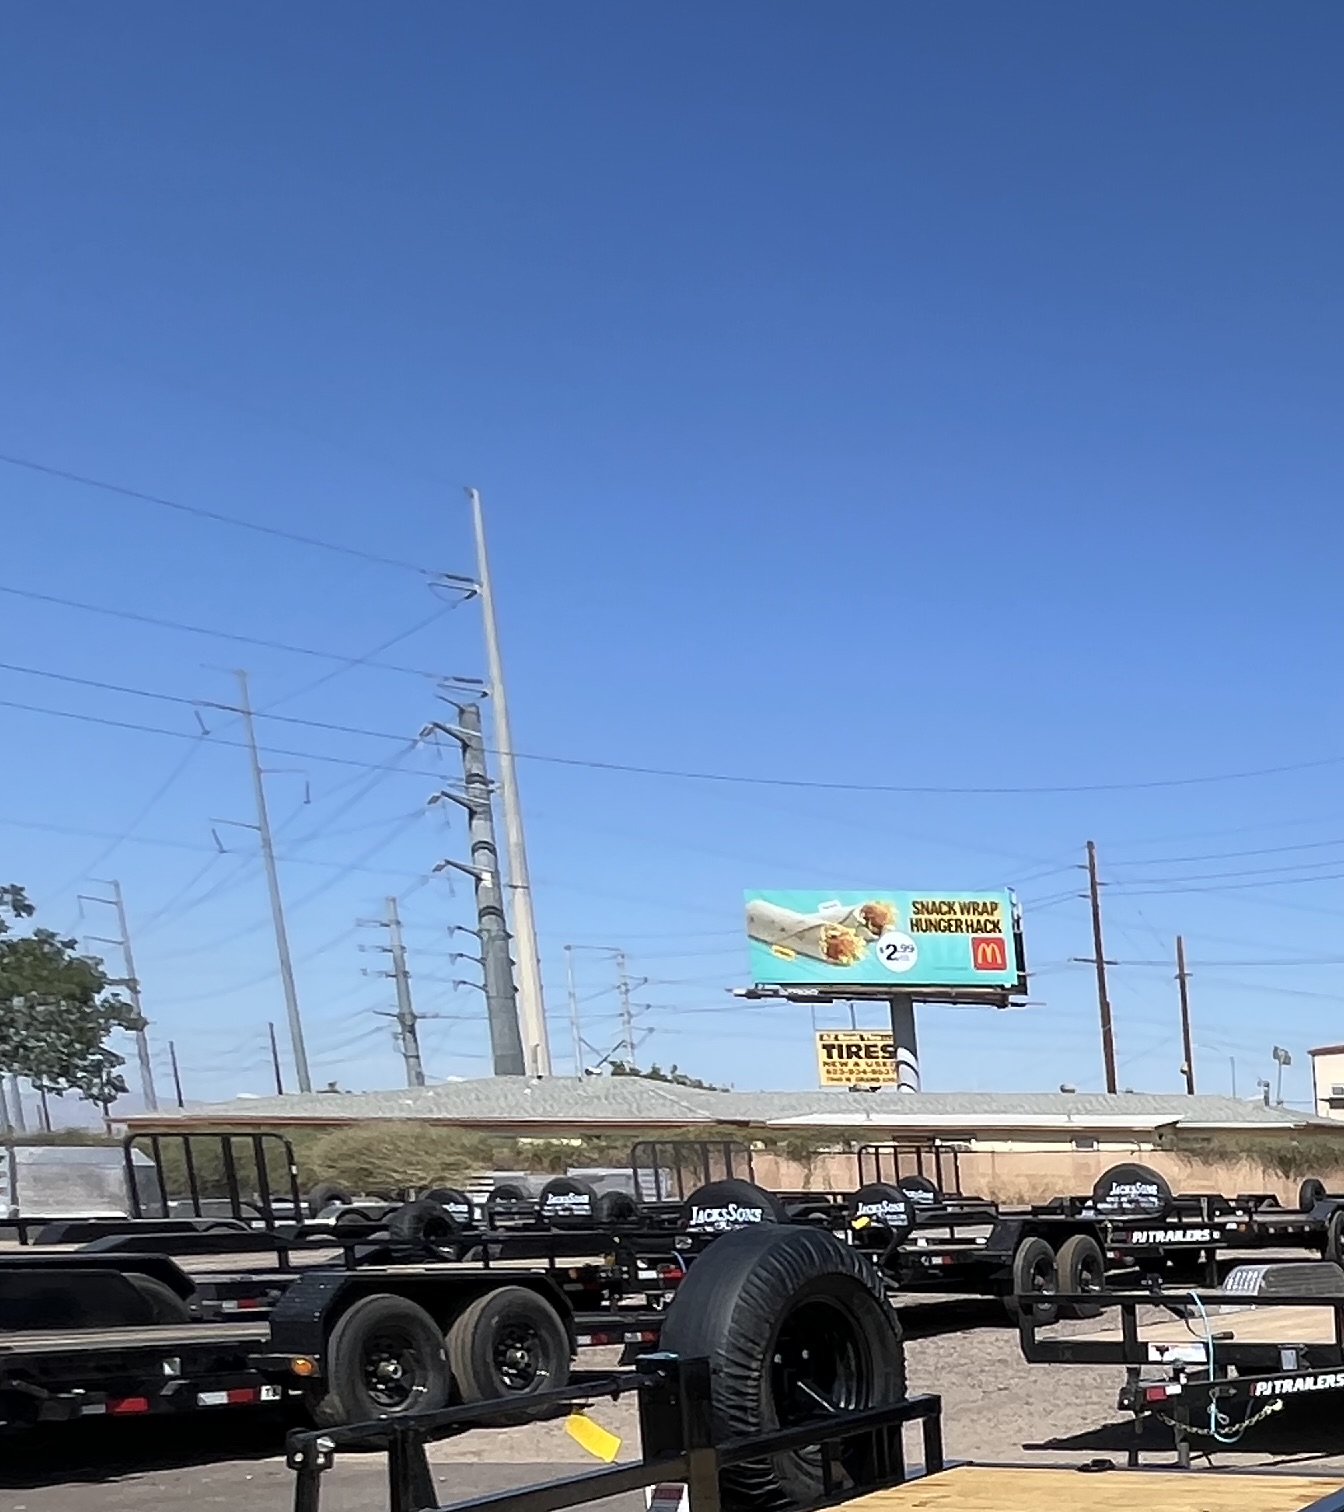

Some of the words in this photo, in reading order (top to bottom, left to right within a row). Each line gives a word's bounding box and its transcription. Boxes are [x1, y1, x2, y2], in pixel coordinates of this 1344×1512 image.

[911, 900, 957, 916] SNACK
[957, 900, 999, 916] WRAP
[909, 917, 964, 933] HUNGER
[965, 918, 1003, 934] HACK
[822, 1043, 896, 1060] TIRES
